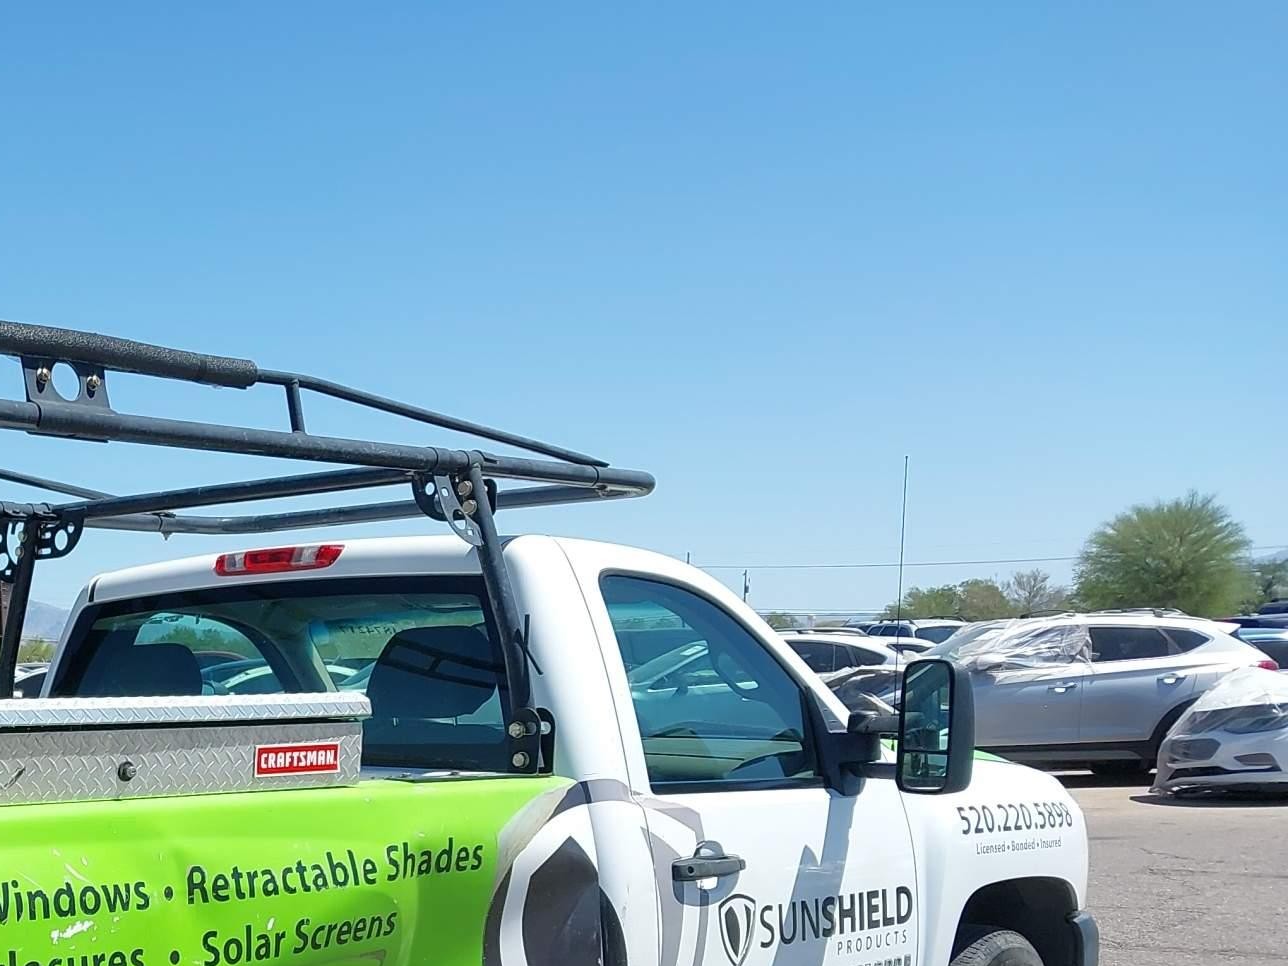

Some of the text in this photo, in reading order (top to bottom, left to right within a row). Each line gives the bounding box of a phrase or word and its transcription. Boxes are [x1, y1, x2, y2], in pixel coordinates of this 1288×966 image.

[260, 750, 336, 768] CRAFTSMAN
[956, 802, 1072, 835] 520.220.5898
[976, 841, 1006, 854] Licensed
[1040, 837, 1062, 849] Insured
[186, 850, 378, 905] Retractable
[386, 837, 484, 882] Shades
[293, 912, 397, 954] Screens
[759, 886, 912, 949] SUNSHIELD
[837, 929, 908, 956] PRODUCTS
